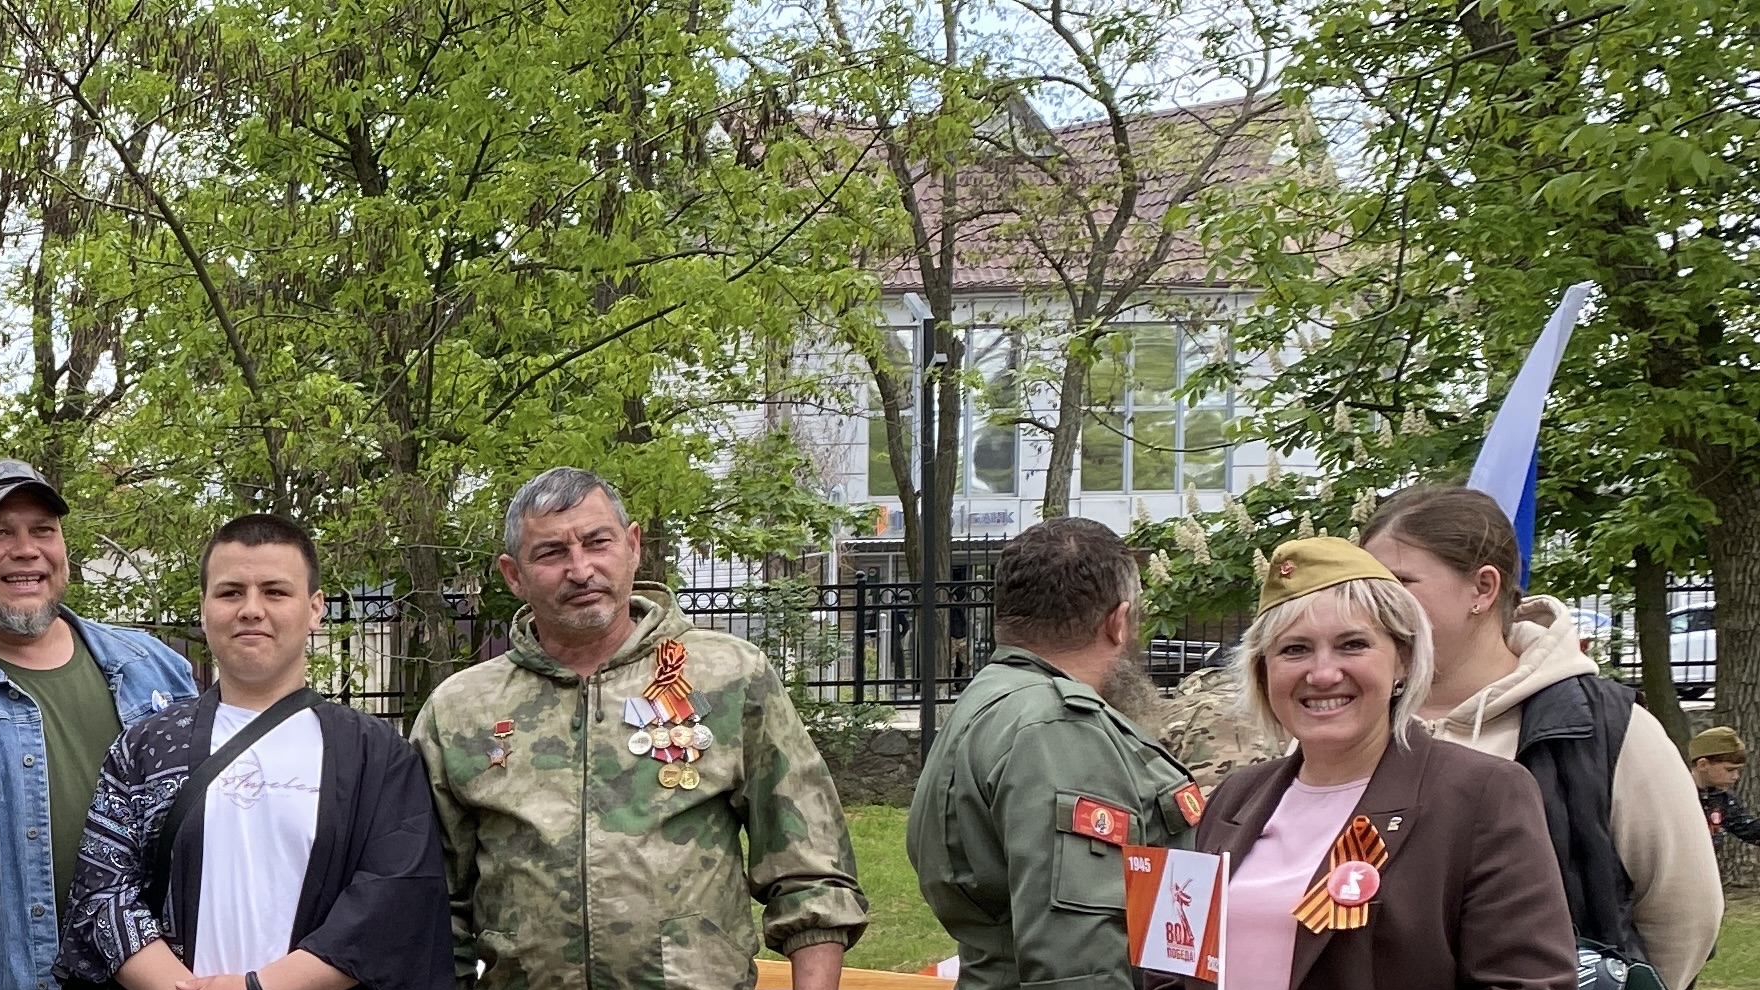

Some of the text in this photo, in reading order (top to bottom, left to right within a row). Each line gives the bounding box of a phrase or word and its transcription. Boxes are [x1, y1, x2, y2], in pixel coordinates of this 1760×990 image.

[1128, 856, 1152, 873] 1945
[1166, 921, 1182, 945] 80
[1166, 946, 1196, 963] ПОБЕДА!
